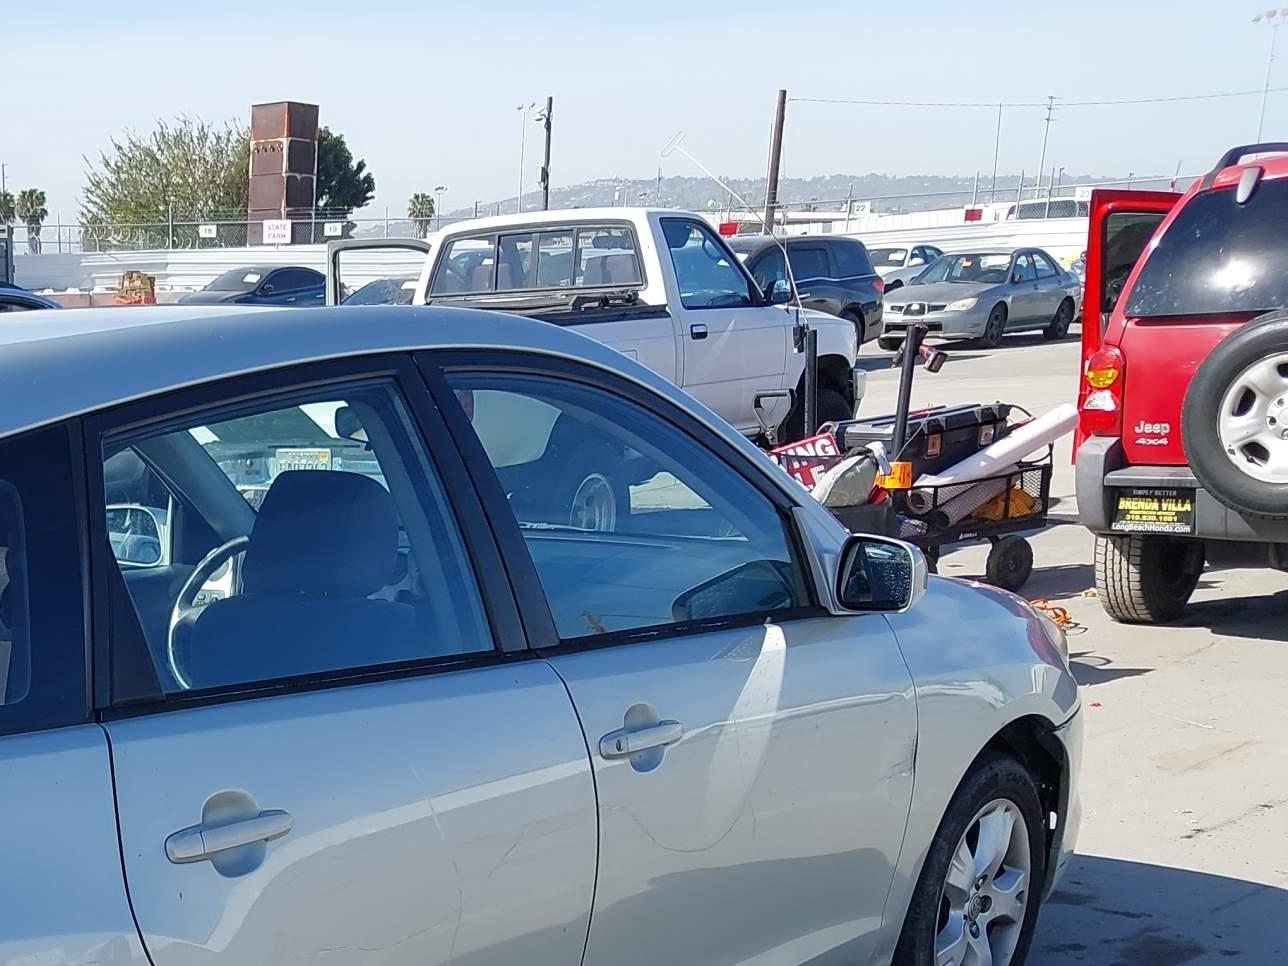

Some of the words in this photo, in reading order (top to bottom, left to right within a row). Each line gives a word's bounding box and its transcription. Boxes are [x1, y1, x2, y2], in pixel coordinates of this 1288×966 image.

[856, 204, 866, 212] 22
[267, 223, 288, 231] STATE
[1134, 420, 1170, 435] Jeep
[1118, 497, 1159, 510] BRENDA
[1161, 498, 1191, 512] VILLA
[1112, 522, 1191, 533] LongBeachHonda.com
